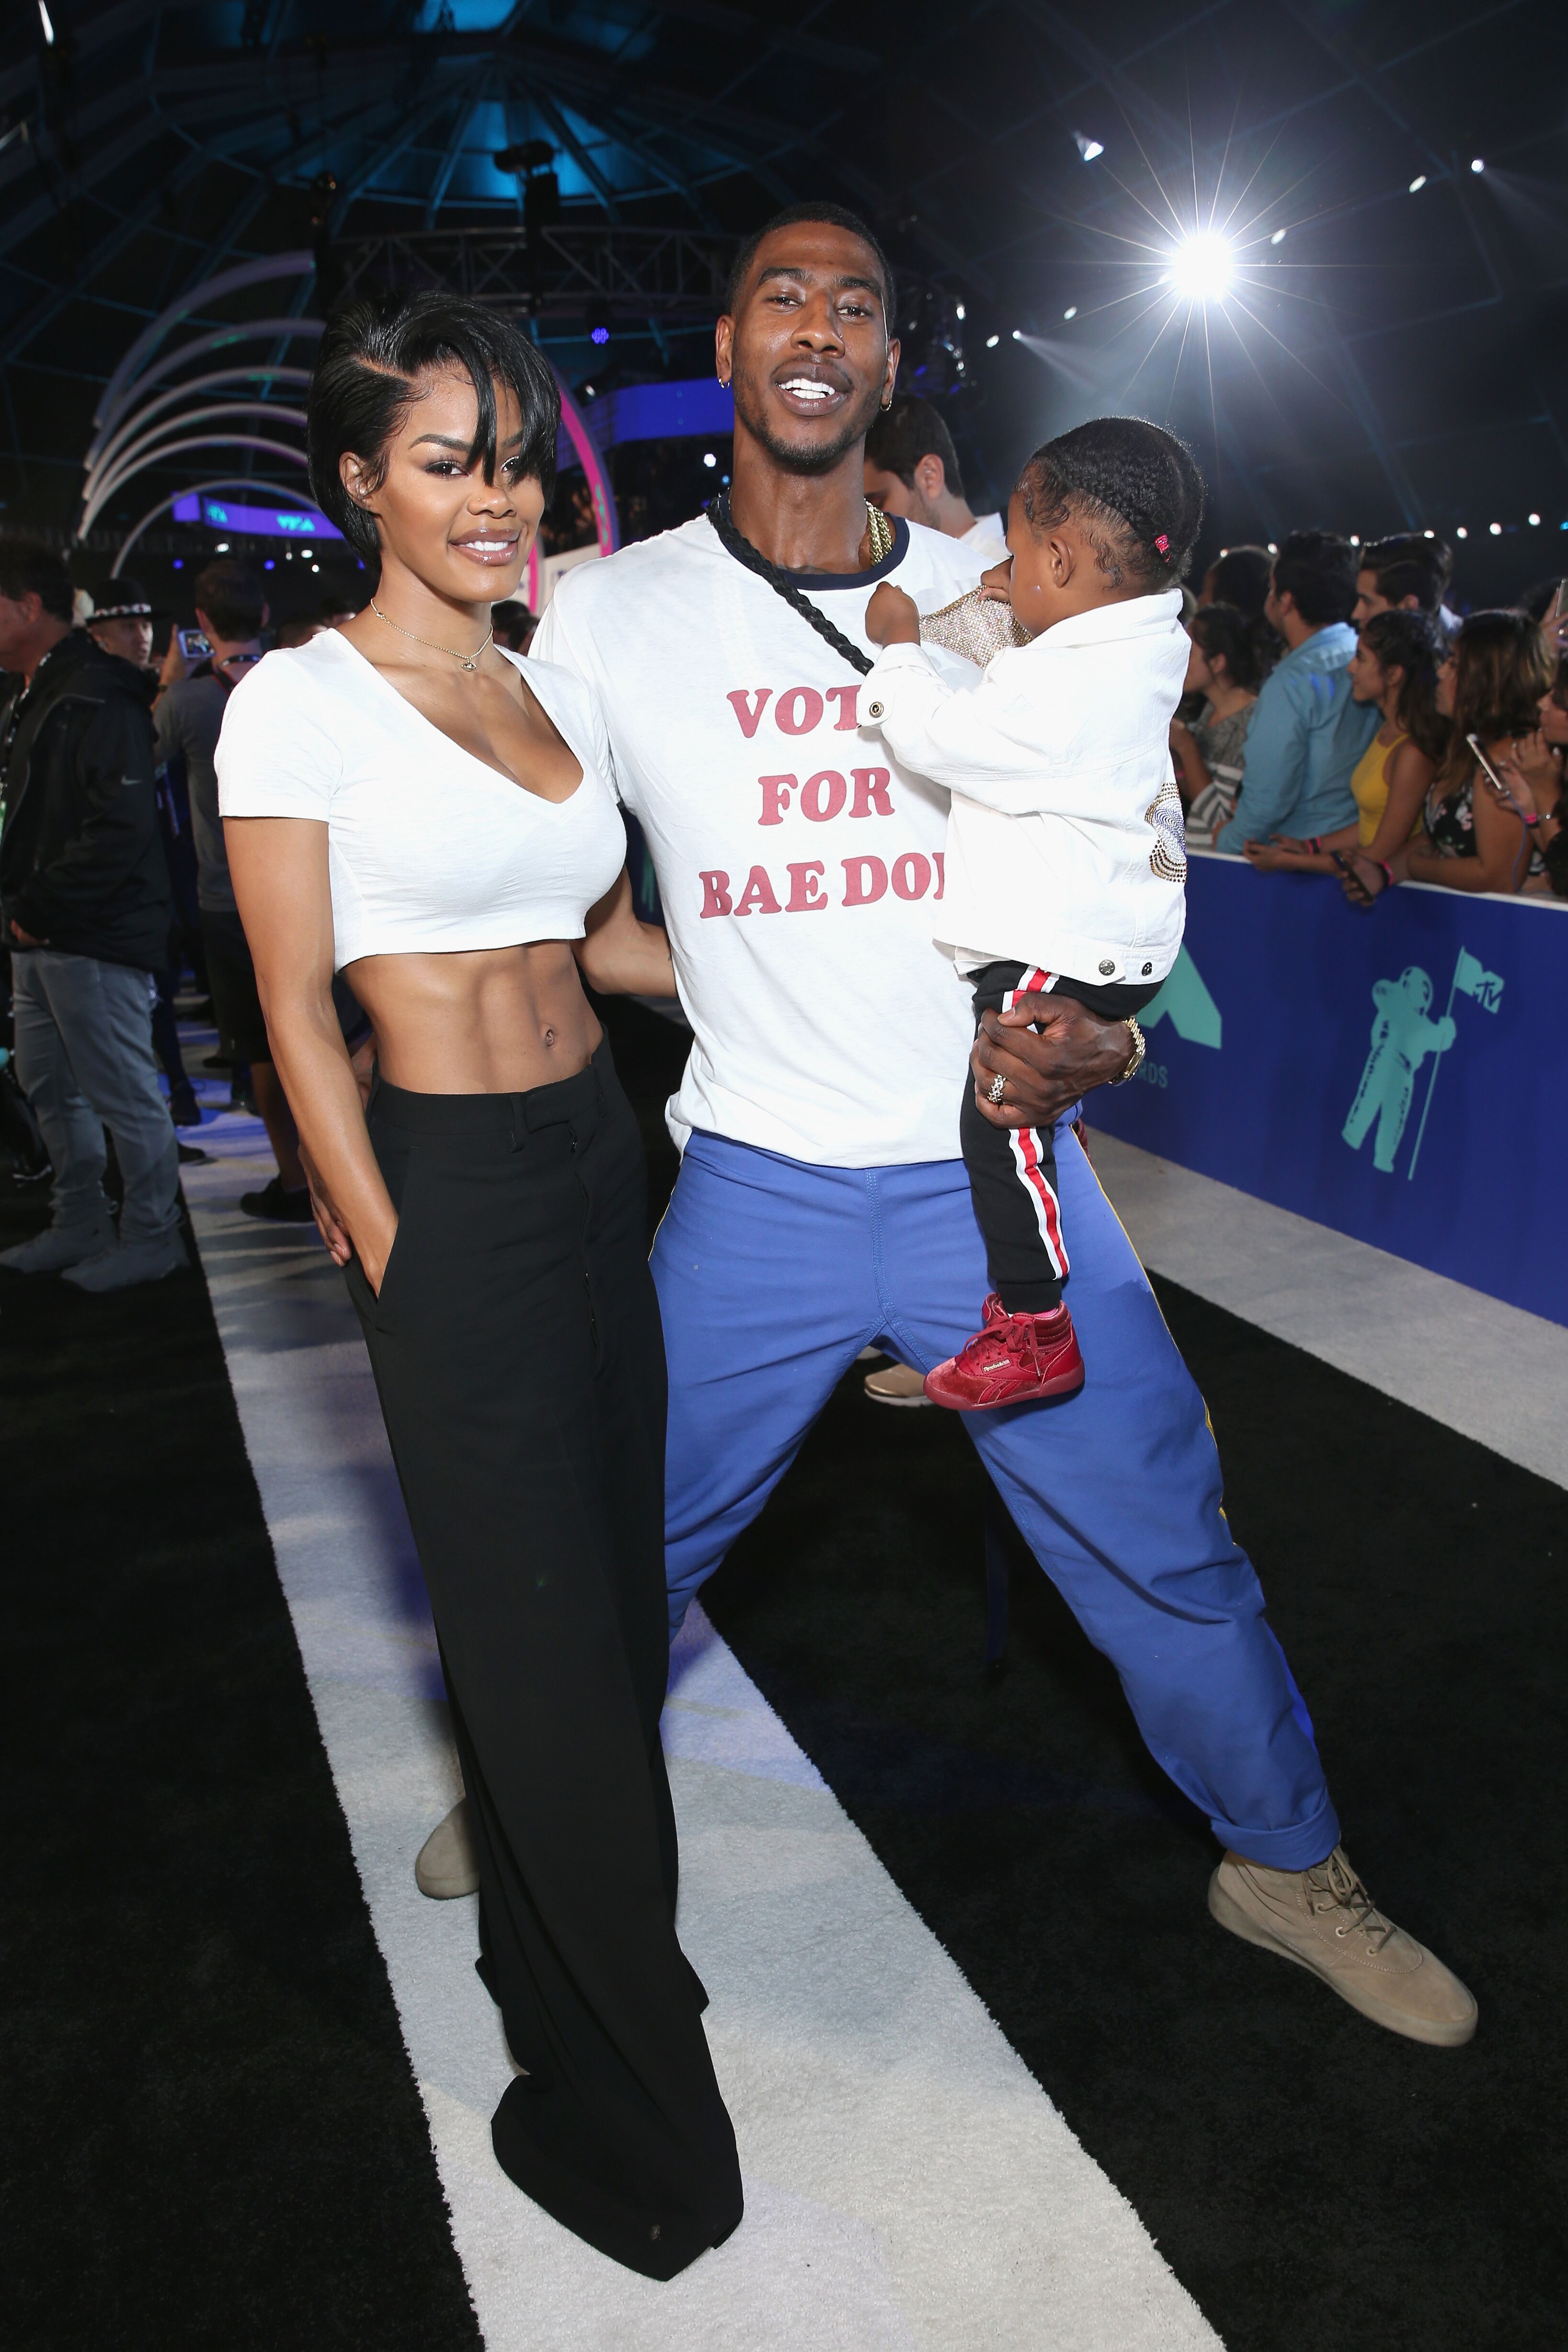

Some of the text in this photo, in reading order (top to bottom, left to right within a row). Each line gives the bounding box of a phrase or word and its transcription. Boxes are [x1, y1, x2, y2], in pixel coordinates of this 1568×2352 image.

[727, 684, 861, 738] VOT
[758, 767, 895, 826] FOR
[698, 860, 828, 919] BAE
[1137, 1059, 1168, 1088] RDS
